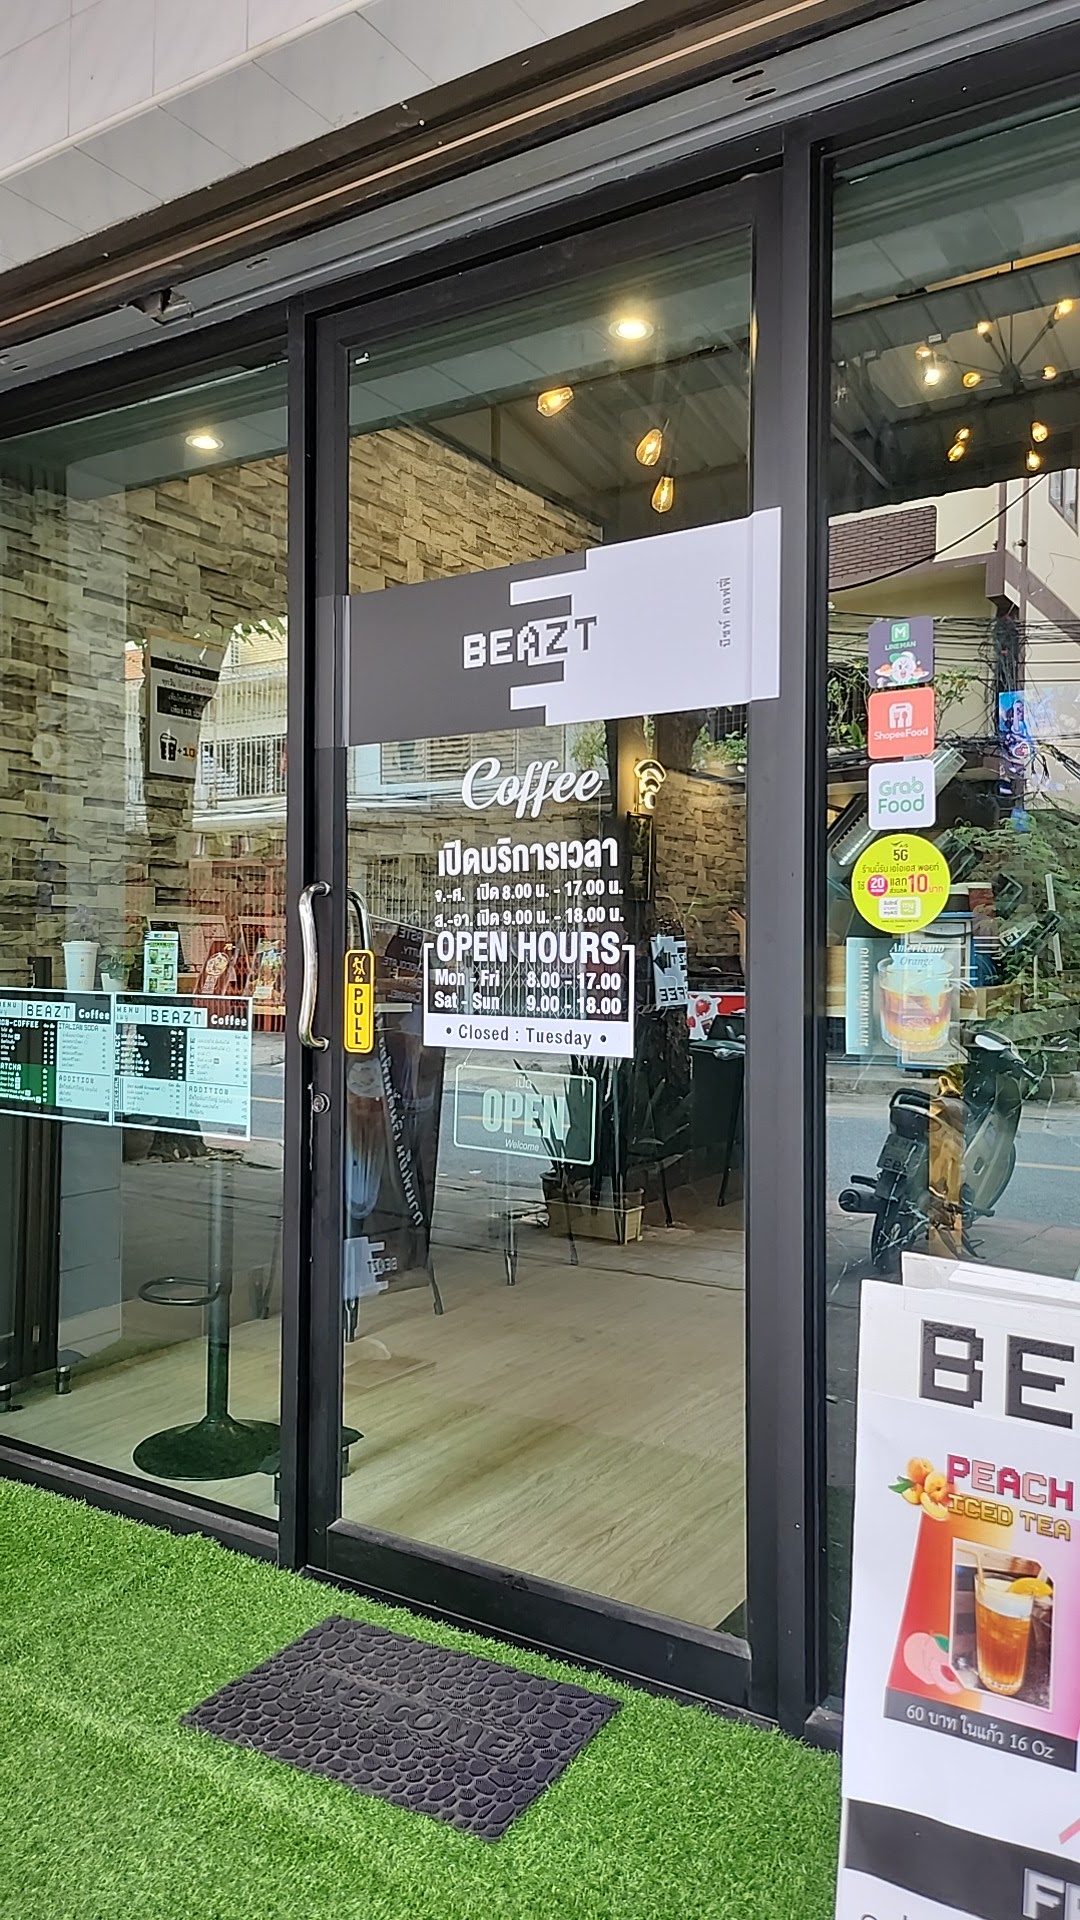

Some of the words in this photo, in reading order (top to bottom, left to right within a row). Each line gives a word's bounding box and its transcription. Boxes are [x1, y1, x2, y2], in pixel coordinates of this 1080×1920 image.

[462, 616, 598, 669] BEAZT
[874, 727, 929, 741] ShopeeFood
[462, 757, 603, 819] Coffee
[879, 776, 924, 796] Grab
[878, 794, 925, 814] Food
[437, 837, 618, 876] เปิดบริการเวลา
[893, 849, 908, 861] 5G
[477, 883, 499, 901] เปิด
[502, 882, 532, 900] 8.00
[535, 884, 549, 898] น.
[565, 879, 605, 897] 17.00
[608, 880, 624, 896] น.
[870, 877, 885, 889] 20
[890, 877, 907, 886] แลก
[908, 873, 928, 893] 10
[477, 909, 500, 926] เปิด
[502, 909, 533, 925] 9.00
[536, 910, 550, 924] น.
[565, 907, 606, 924] 18.00
[608, 907, 624, 922] น.
[436, 931, 508, 963] OPEN
[518, 931, 621, 965] HOURS
[890, 942, 945, 953] Americano
[900, 956, 934, 967] Orange
[434, 969, 465, 987] Mon
[480, 969, 500, 987] Fri
[526, 971, 560, 989] 8.00
[577, 973, 621, 990] 17.00
[27, 1004, 71, 1019] BEAZT
[78, 1008, 110, 1020] Coffee
[434, 991, 458, 1009] Sat
[472, 993, 500, 1010] Sun
[526, 995, 560, 1012] 9.00
[577, 996, 622, 1014] 18.00
[59, 1022, 83, 1031] ITALIAN
[151, 1009, 202, 1025] BEAZT
[210, 1014, 248, 1026] Coffee
[354, 988, 364, 1044] PULL
[458, 1024, 509, 1042] Closed
[526, 1027, 592, 1048] Tuesday
[482, 1088, 566, 1141] OPEN
[505, 1138, 540, 1152] Welcome
[919, 1319, 1075, 1429] BE
[947, 1454, 1074, 1512] PEACH
[948, 1493, 1014, 1527] ICED
[1020, 1510, 1071, 1541] TEA
[906, 1704, 923, 1721] 60
[928, 1711, 957, 1731] บาท
[960, 1714, 1005, 1745] ในแก้ว
[1009, 1733, 1028, 1751] 16
[1032, 1740, 1055, 1759] Oz
